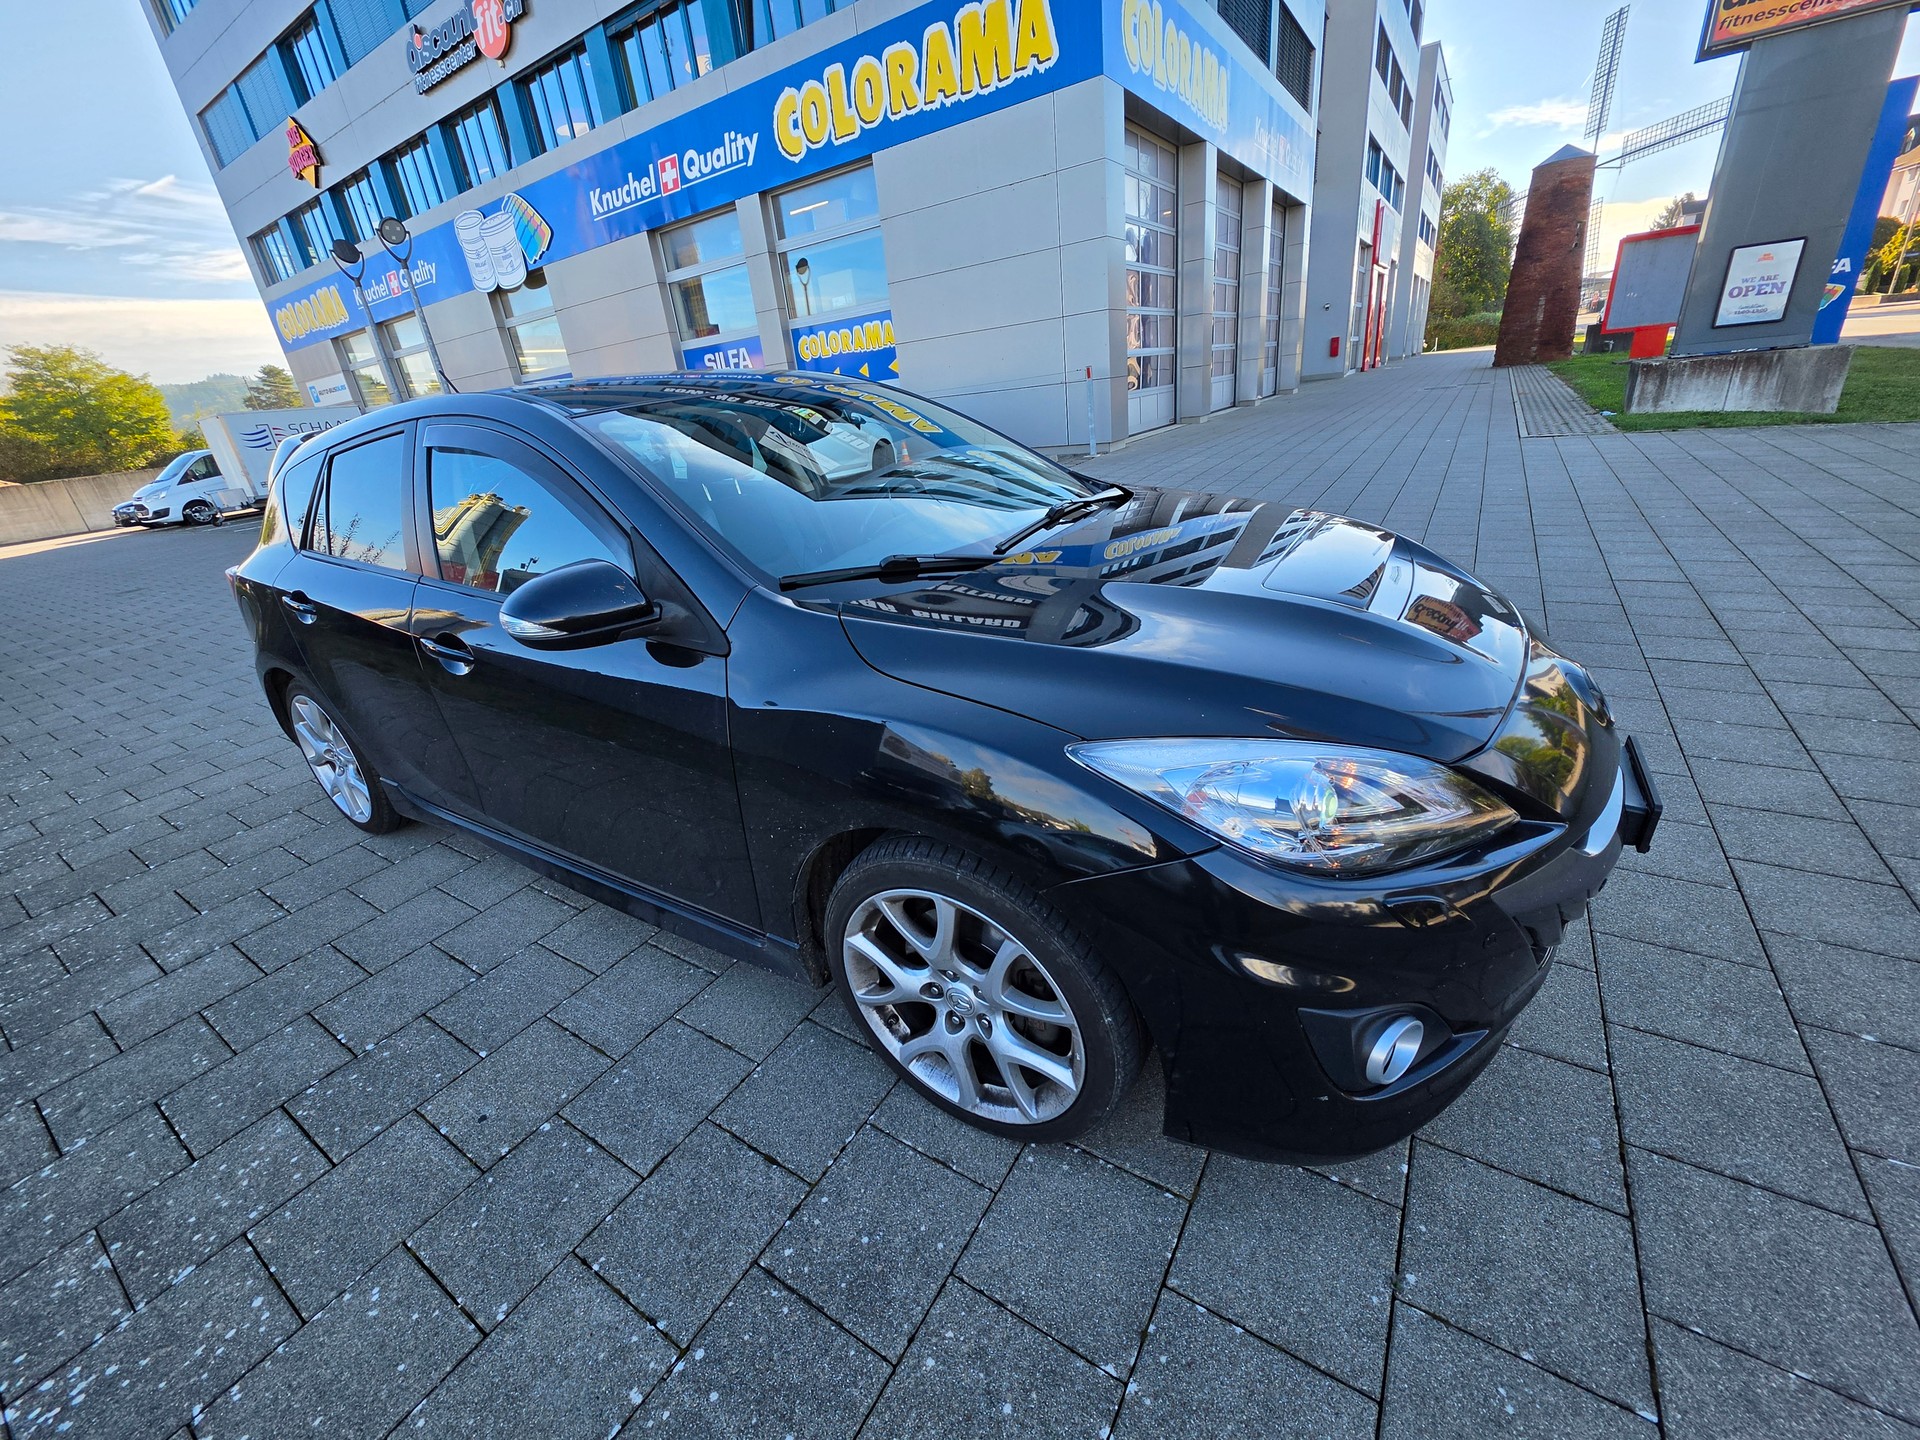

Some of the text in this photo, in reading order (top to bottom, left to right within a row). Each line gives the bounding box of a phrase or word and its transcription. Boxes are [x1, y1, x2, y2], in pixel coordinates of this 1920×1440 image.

[414, 39, 477, 95] fitnesscenter
[773, 0, 1059, 162] COLORAMA
[1122, 0, 1232, 135] COLORAMA
[285, 125, 303, 149] BIG
[288, 144, 317, 179] BURGER
[589, 131, 759, 217] Knuchel Quality
[1728, 280, 1787, 299] OPEN
[1741, 273, 1780, 284] WE ARE
[276, 283, 349, 344] COLORAMA
[703, 346, 754, 370] SILFA
[798, 319, 896, 361] COLORAMA
